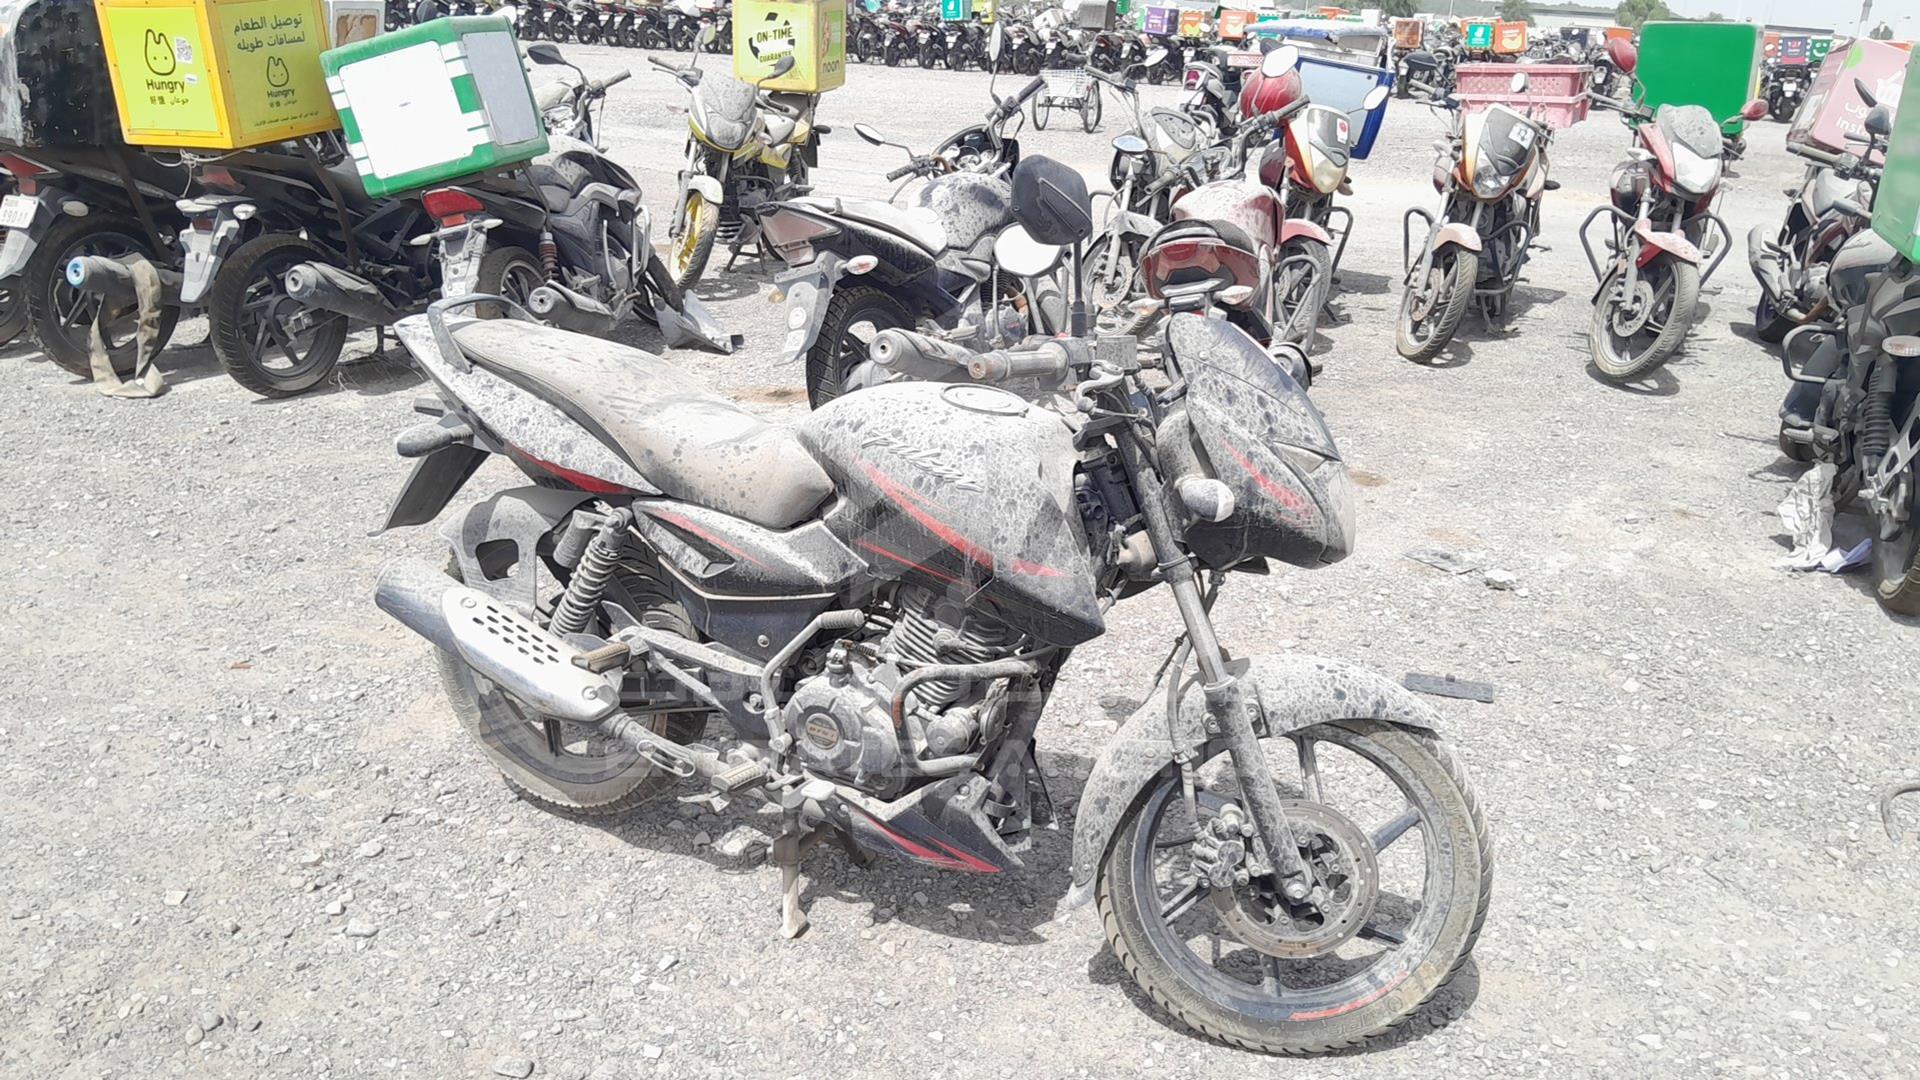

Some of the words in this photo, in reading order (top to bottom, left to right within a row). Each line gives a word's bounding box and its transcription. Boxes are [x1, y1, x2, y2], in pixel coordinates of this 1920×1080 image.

[234, 16, 267, 35] الطعام
[271, 13, 303, 30] توصيل
[757, 27, 792, 43] ON-TIME
[823, 60, 840, 73] noon
[146, 79, 185, 93] Hungry
[267, 88, 295, 99] Hungry
